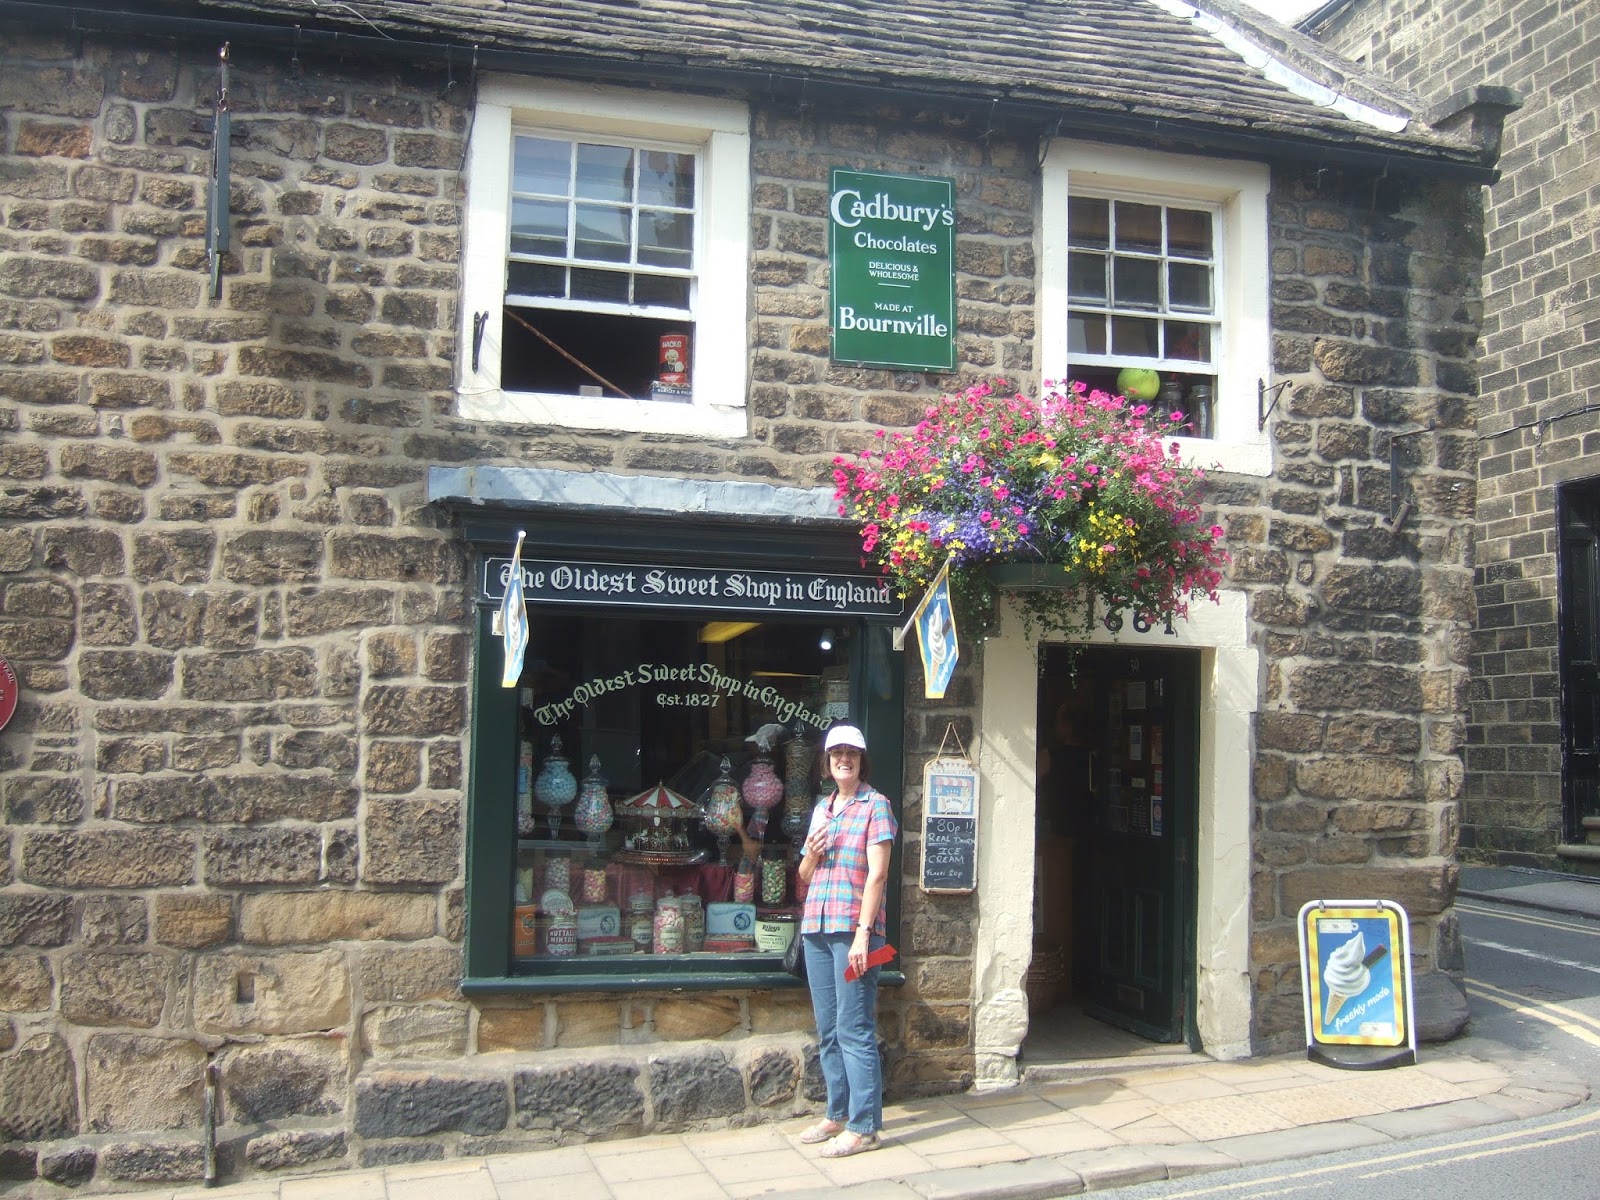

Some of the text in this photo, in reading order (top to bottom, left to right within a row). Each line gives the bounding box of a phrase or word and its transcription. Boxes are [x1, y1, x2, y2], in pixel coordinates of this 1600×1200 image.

[830, 189, 954, 231] Cadbury's
[854, 231, 937, 254] Chocolates
[869, 261, 911, 272] DELICIOUS
[869, 270, 919, 281] WHOLESOME
[874, 302, 914, 313] MADE AT
[840, 306, 948, 338] Bournville
[551, 565, 636, 596] Oldest
[641, 569, 719, 595] Sweet
[723, 573, 782, 606] Shop
[786, 577, 804, 600] in
[808, 577, 892, 609] England
[533, 663, 833, 731] The Oldest Sweet Shop in England
[656, 693, 720, 708] Est. 1827
[937, 819, 960, 835] 80p
[928, 832, 950, 842] REAL
[937, 847, 961, 855] ICE
[928, 855, 964, 864] CREAM
[1335, 1003, 1366, 1032] freshly
[1367, 986, 1390, 1007] made
